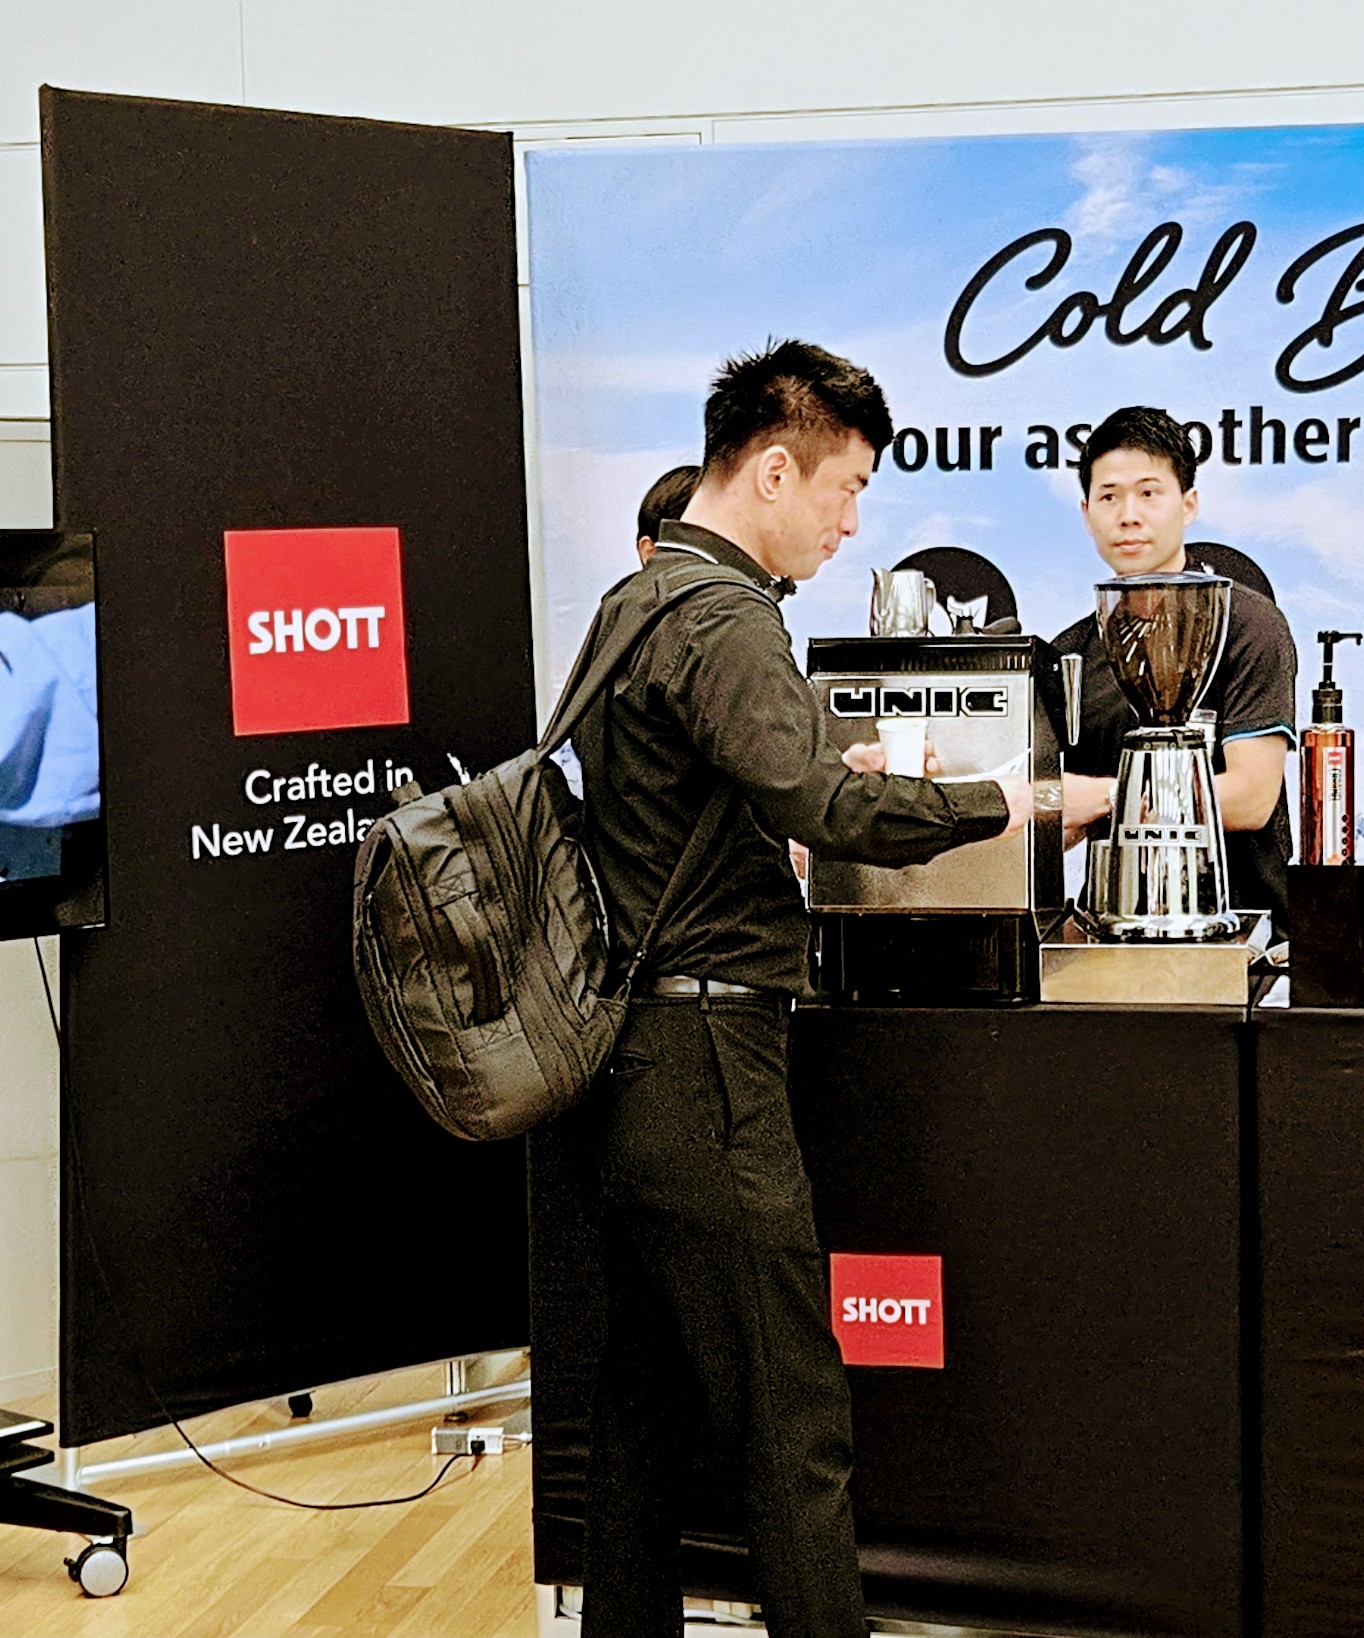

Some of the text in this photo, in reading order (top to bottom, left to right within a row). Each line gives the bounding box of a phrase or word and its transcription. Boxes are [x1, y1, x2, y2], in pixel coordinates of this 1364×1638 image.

[943, 220, 1258, 377] Cold
[1186, 405, 1359, 465] other
[247, 606, 386, 655] SHOTT
[829, 685, 1009, 718] UNIC
[245, 759, 375, 805] Crafted
[191, 809, 376, 860] New Zeala
[1123, 827, 1203, 843] UNIC
[842, 1296, 932, 1325] SHOTT
